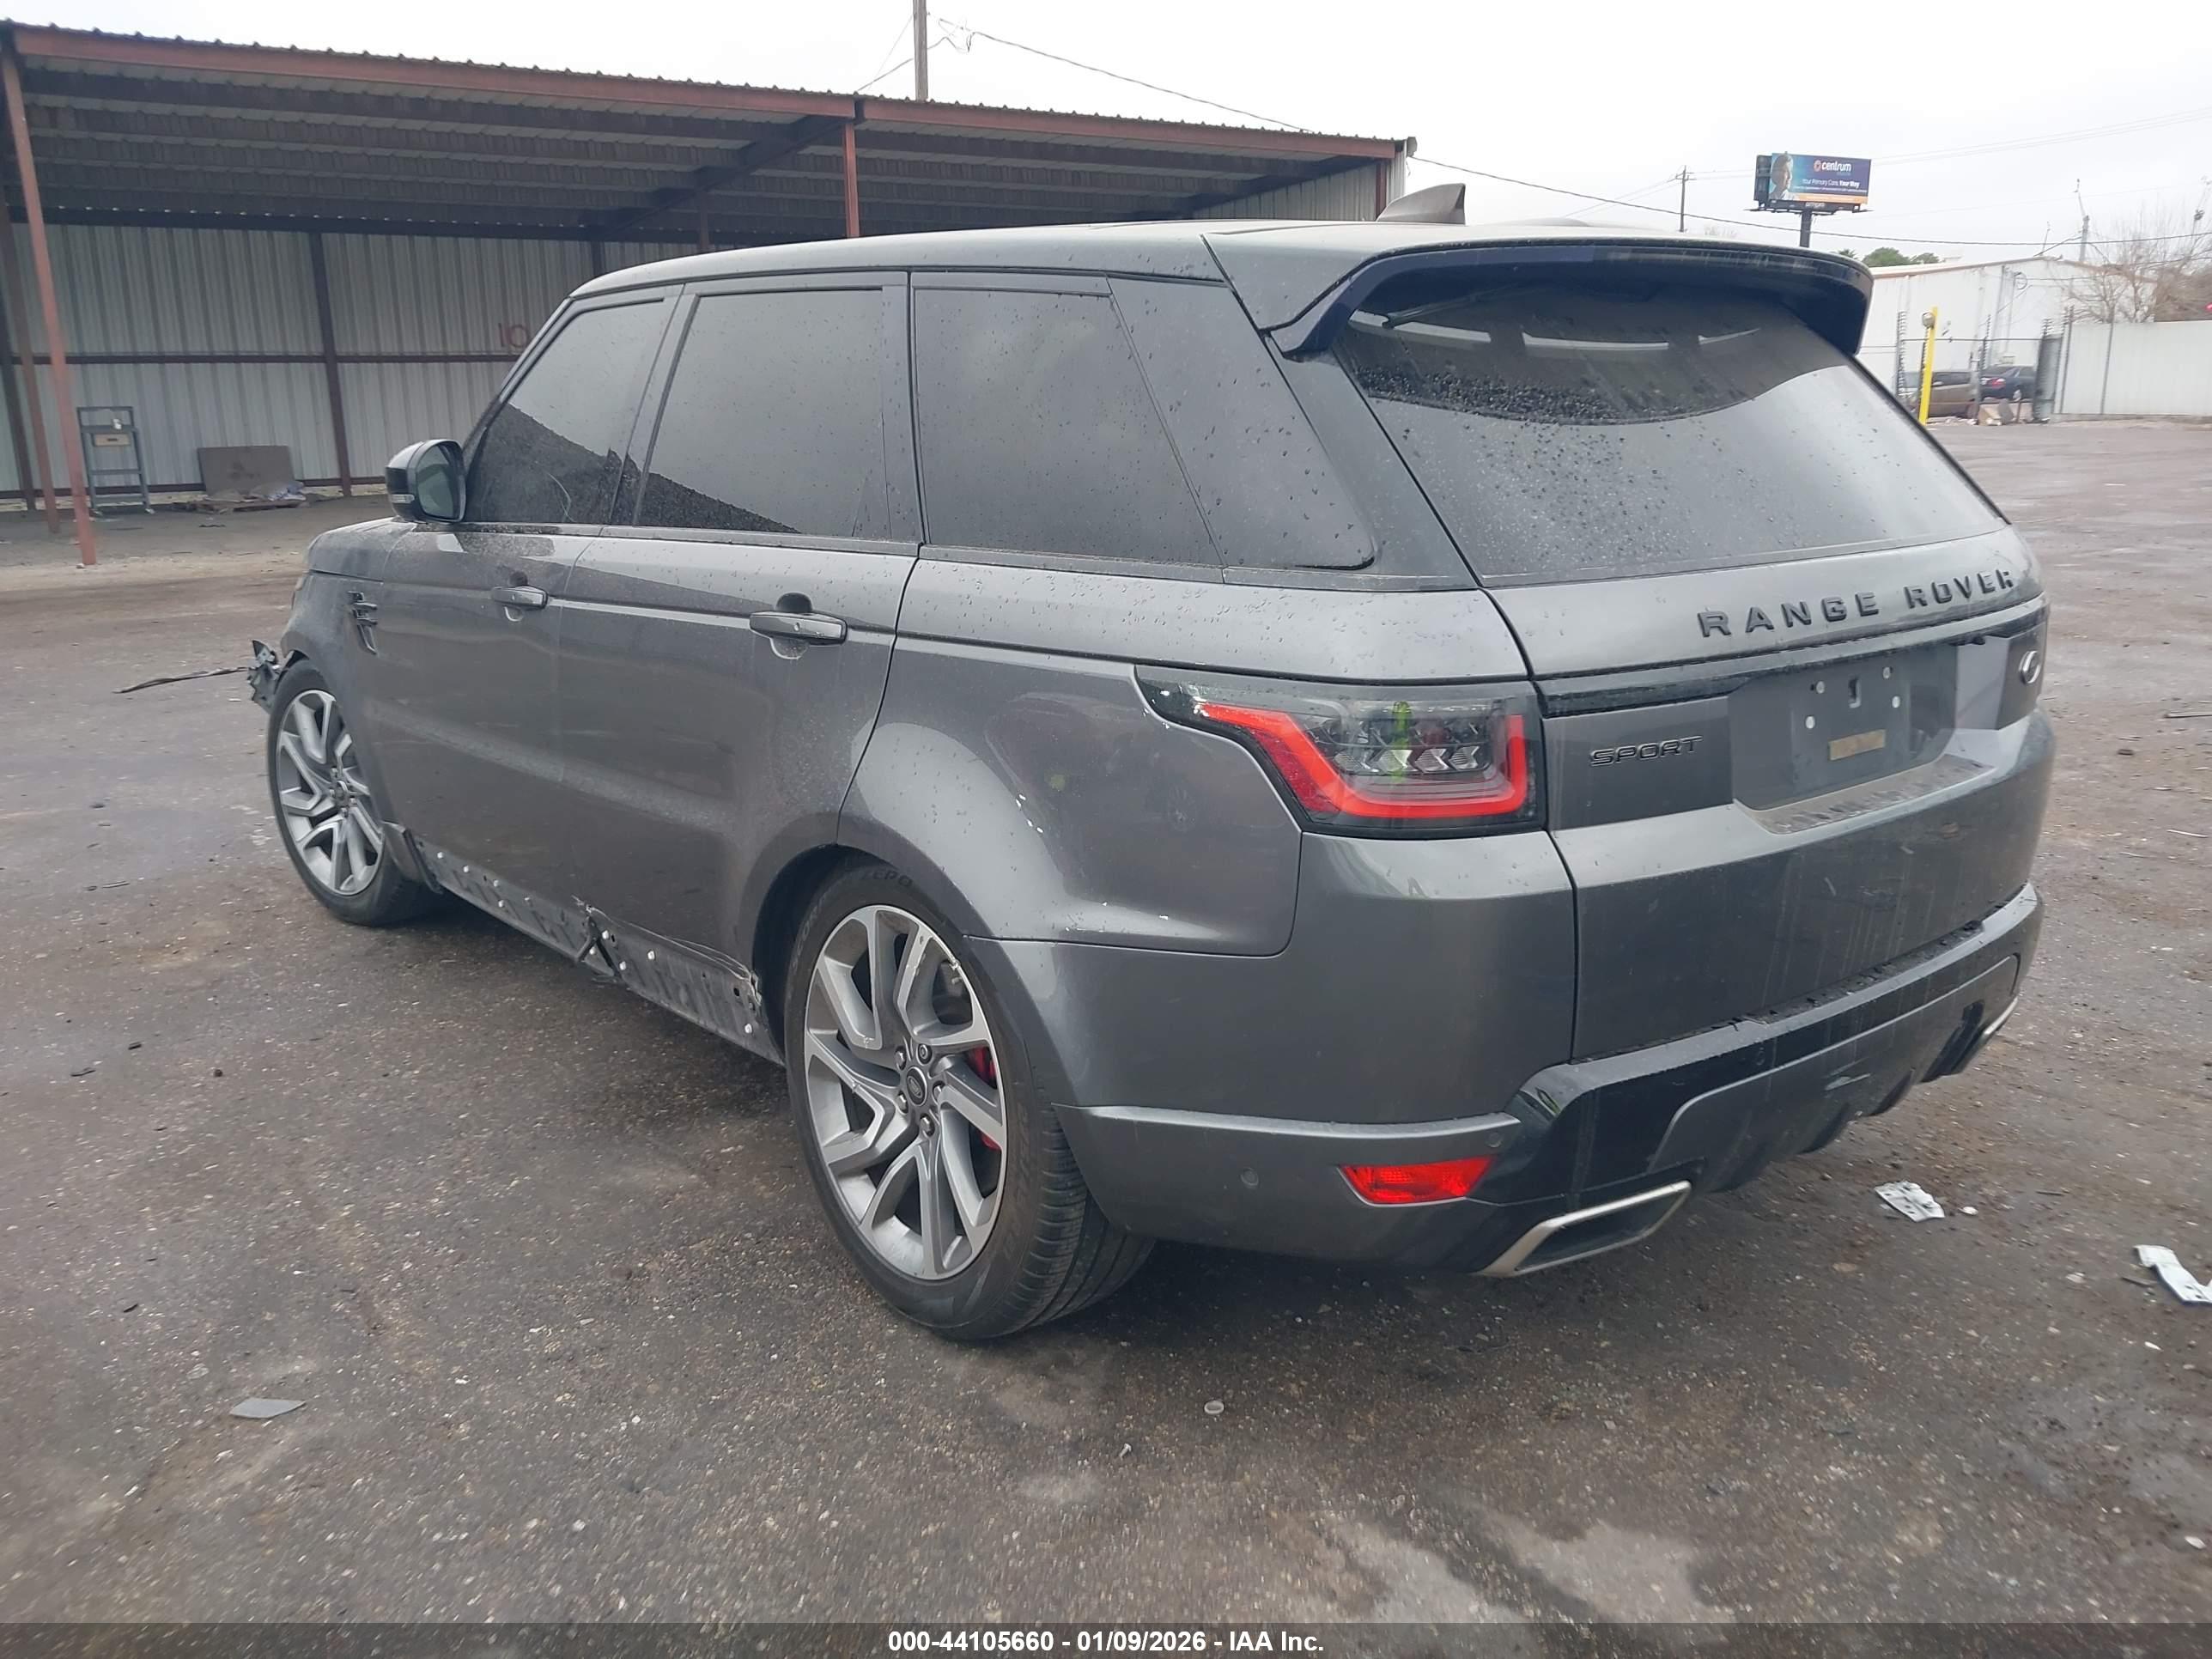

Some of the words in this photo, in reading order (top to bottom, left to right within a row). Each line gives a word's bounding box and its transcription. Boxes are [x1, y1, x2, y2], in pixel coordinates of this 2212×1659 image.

[1821, 161, 1851, 173] centrum
[1697, 591, 1880, 637] RANGE
[1903, 568, 2014, 609] ROVER
[1590, 735, 1703, 767] SPORT
